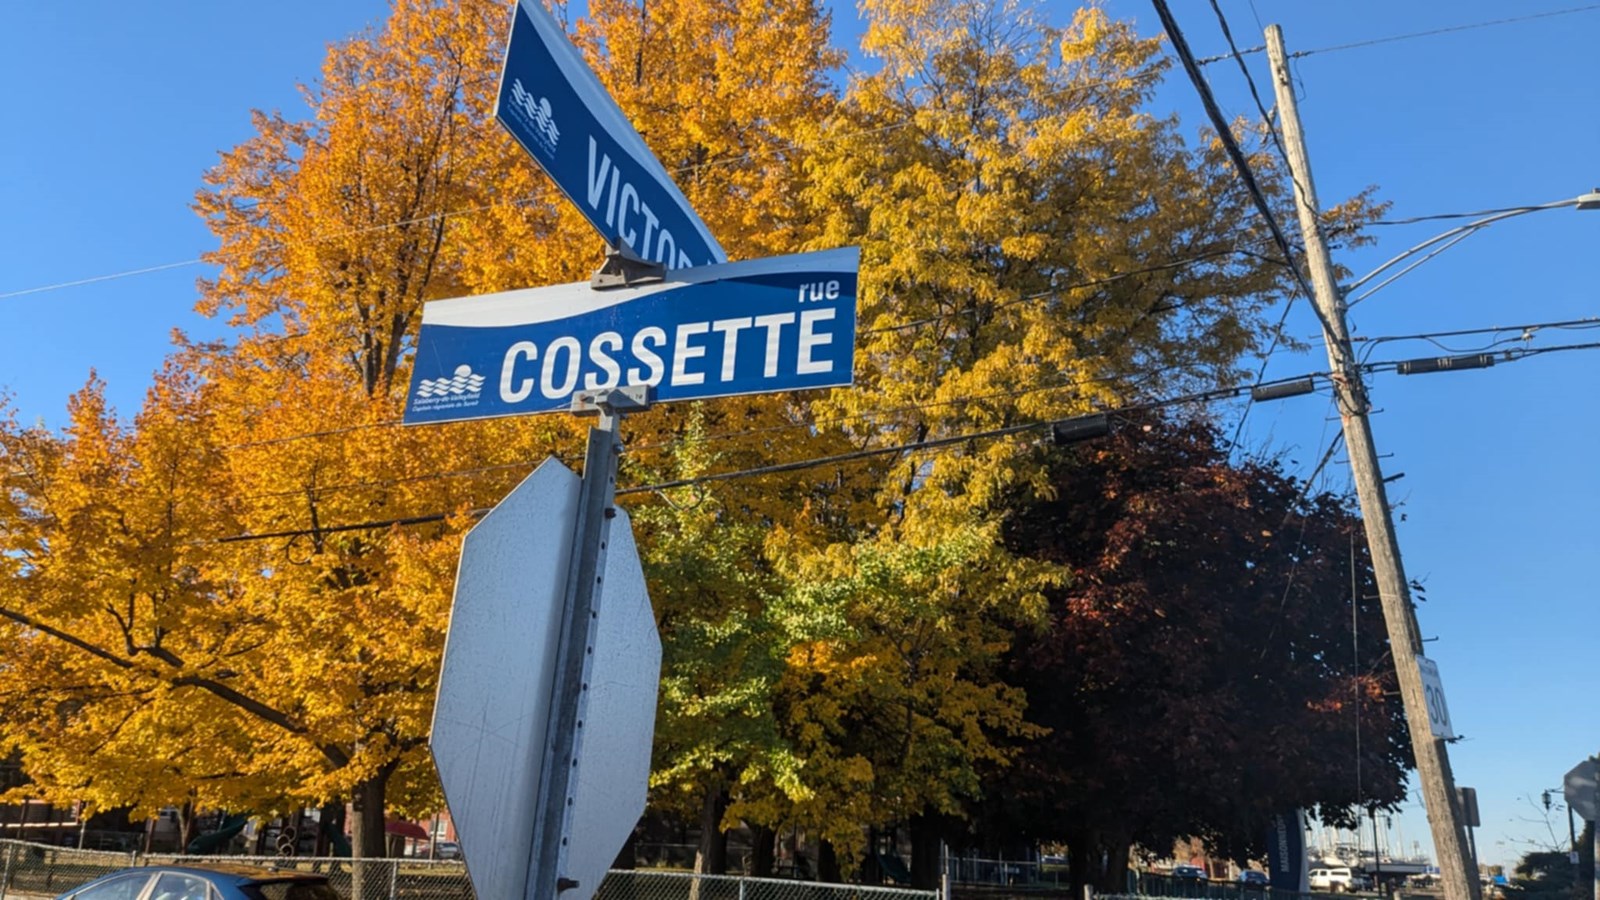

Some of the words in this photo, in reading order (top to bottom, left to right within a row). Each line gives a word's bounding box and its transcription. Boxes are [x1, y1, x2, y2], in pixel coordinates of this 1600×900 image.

[799, 280, 840, 303] rue
[500, 307, 836, 403] COSSETTE
[1426, 684, 1447, 727] 30
